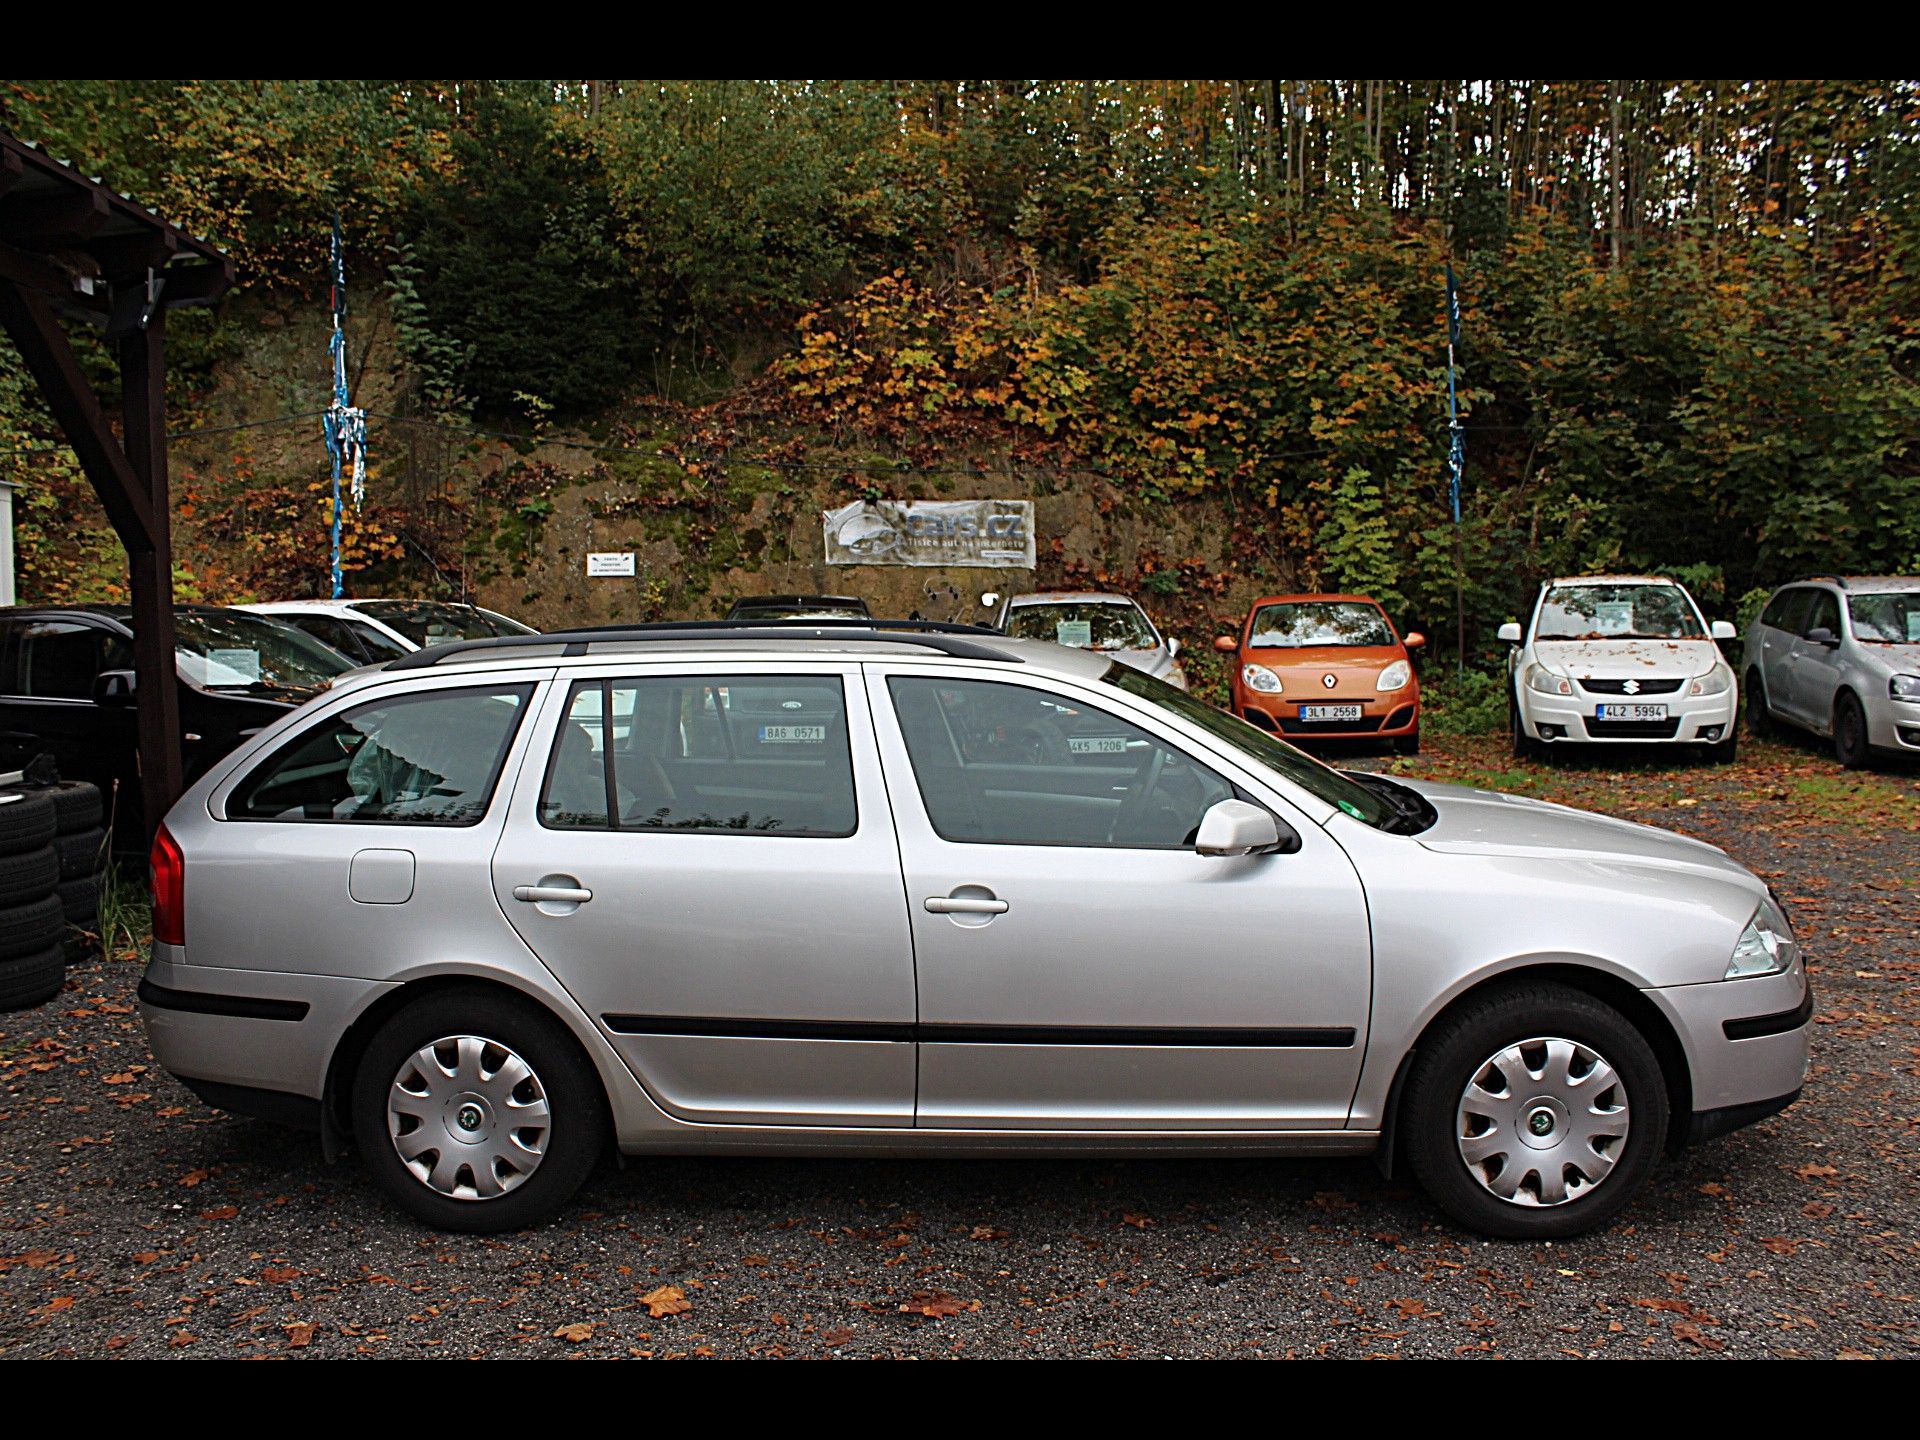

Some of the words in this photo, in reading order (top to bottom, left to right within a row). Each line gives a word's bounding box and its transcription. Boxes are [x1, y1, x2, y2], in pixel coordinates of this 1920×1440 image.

[1308, 707, 1326, 717] 3L1
[1333, 706, 1357, 717] 2558
[1606, 706, 1626, 717] 4L2
[1634, 706, 1661, 717] 5994
[767, 727, 786, 738] 8A6
[794, 727, 820, 738] 0571
[1097, 741, 1122, 751] 1206
